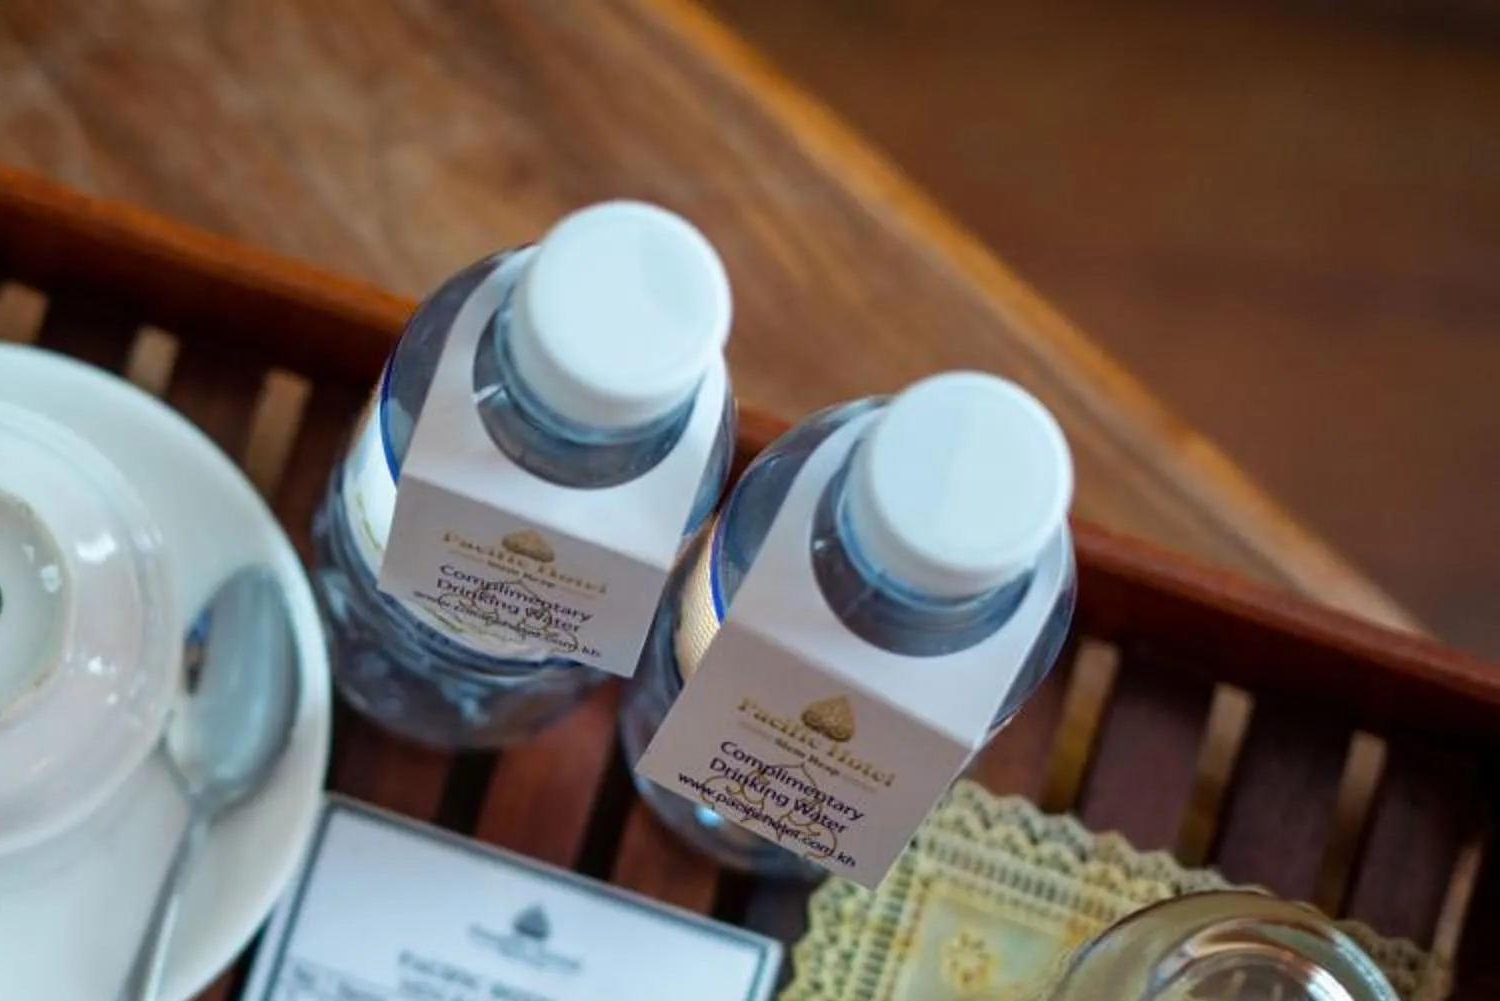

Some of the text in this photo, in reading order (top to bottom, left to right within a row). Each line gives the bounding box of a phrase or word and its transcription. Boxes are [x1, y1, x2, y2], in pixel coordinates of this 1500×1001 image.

[436, 577, 582, 634] Drinking Water
[438, 563, 594, 623] Complimentary
[708, 756, 848, 836] Drinking Water
[720, 740, 866, 822] Complimentary
